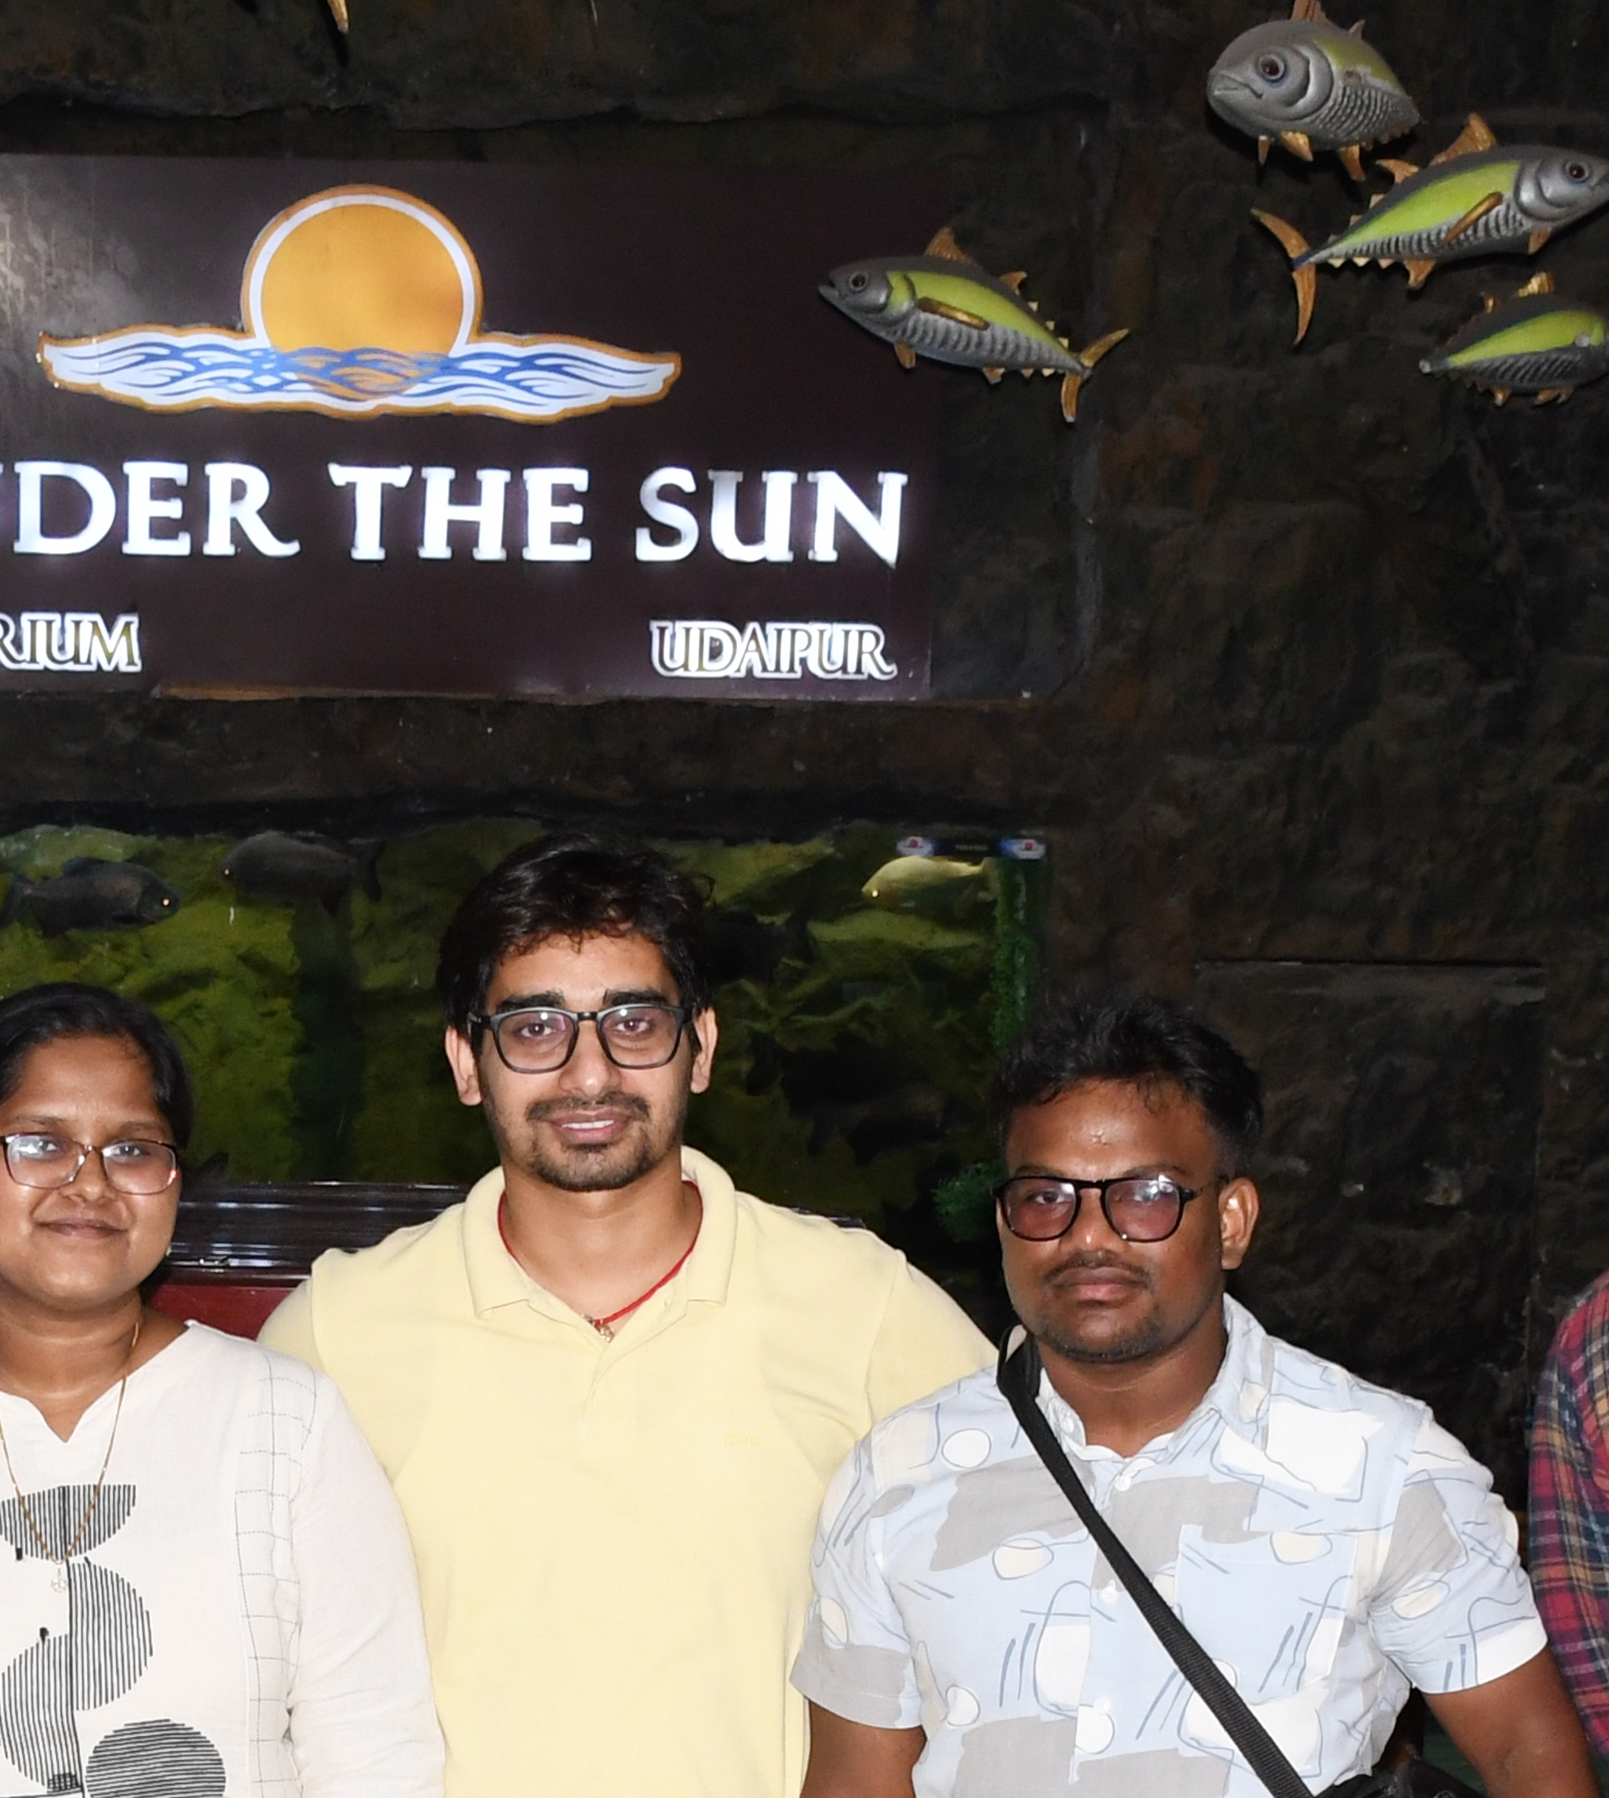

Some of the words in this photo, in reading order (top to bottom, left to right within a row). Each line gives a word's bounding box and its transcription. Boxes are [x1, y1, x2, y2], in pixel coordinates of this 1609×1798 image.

[328, 462, 592, 564] THE
[635, 465, 909, 570] SUN
[649, 620, 899, 681] UDAIPUR
